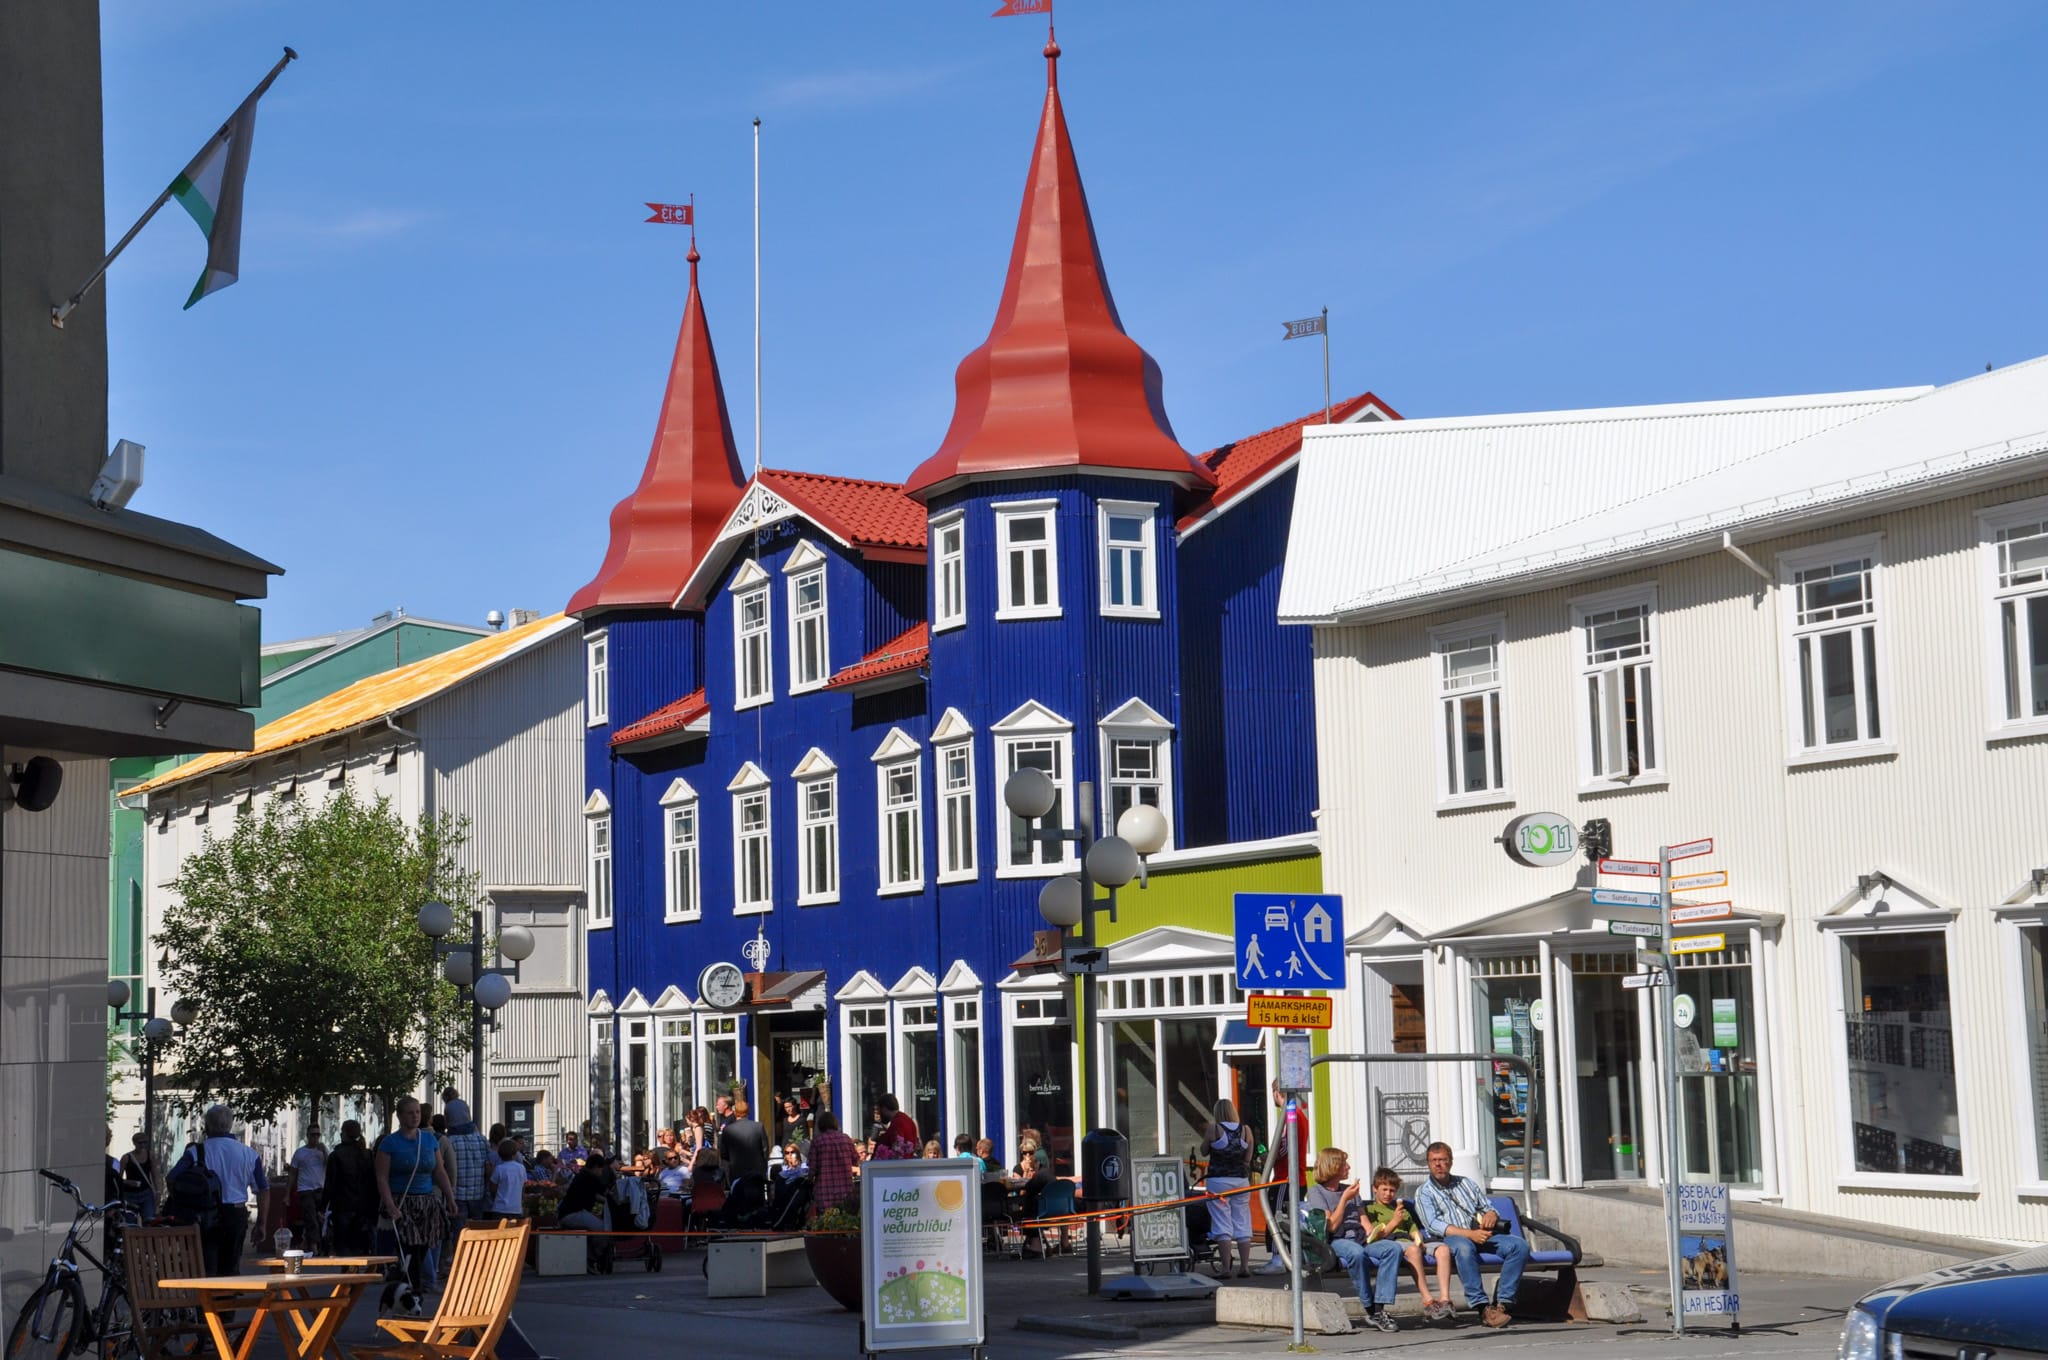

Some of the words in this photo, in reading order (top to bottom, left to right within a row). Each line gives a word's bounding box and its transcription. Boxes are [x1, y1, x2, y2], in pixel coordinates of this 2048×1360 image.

[1253, 999, 1328, 1011] HÁMARKSHRAÐI
[1259, 1012, 1271, 1023] 15
[1274, 1013, 1290, 1023] km
[1292, 1012, 1299, 1023] á
[1137, 1171, 1178, 1197] 600
[882, 1188, 919, 1203] Lokað
[882, 1205, 919, 1221] vegna
[1682, 1199, 1717, 1213] RIDING
[1704, 1294, 1740, 1313] HESTAR
